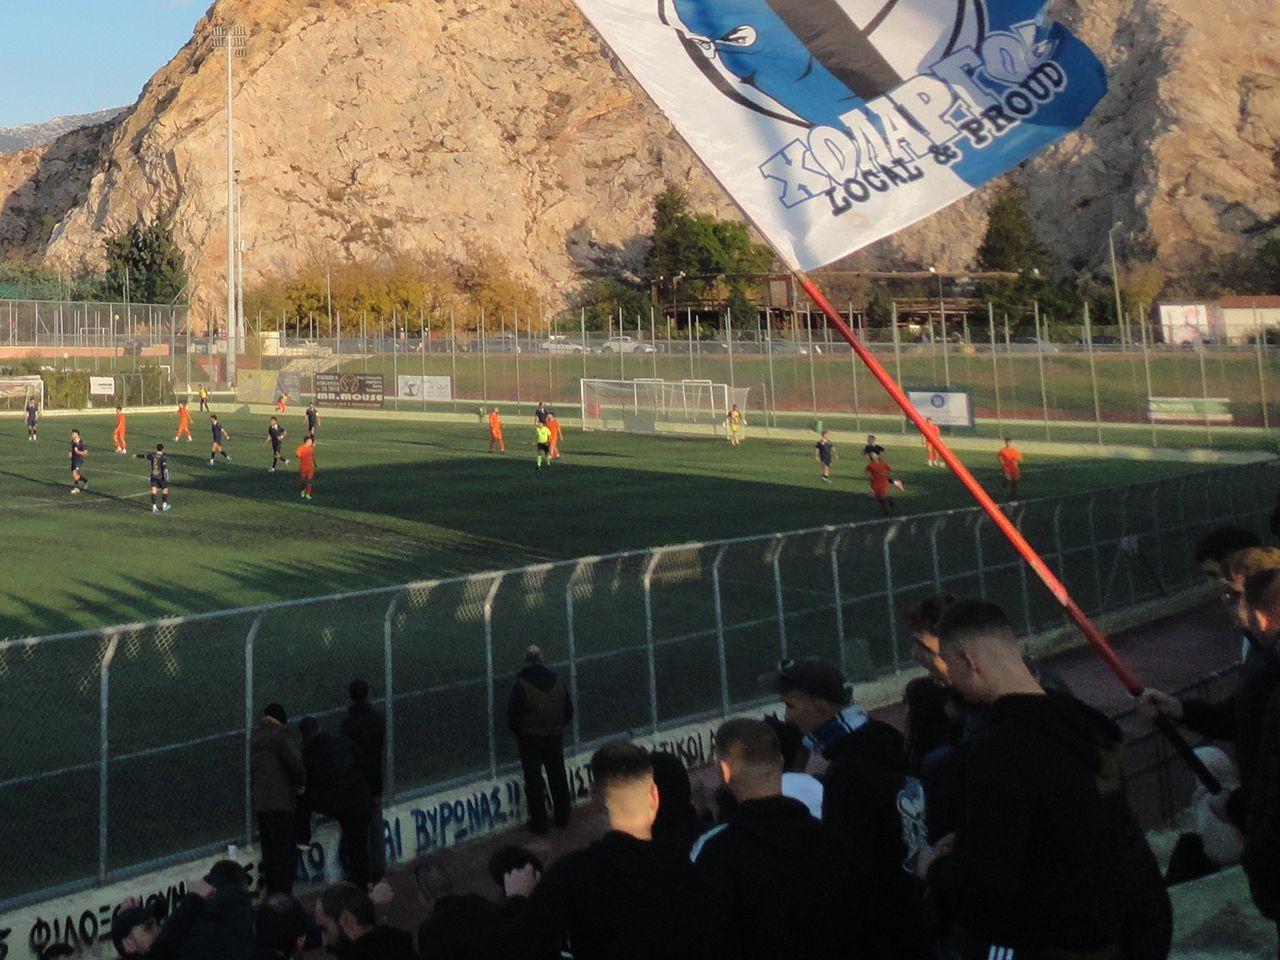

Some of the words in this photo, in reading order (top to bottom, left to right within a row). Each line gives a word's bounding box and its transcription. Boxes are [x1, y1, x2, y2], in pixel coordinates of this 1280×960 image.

[825, 158, 924, 217] LOCAL
[929, 143, 958, 166] &
[960, 62, 1065, 145] PROUD
